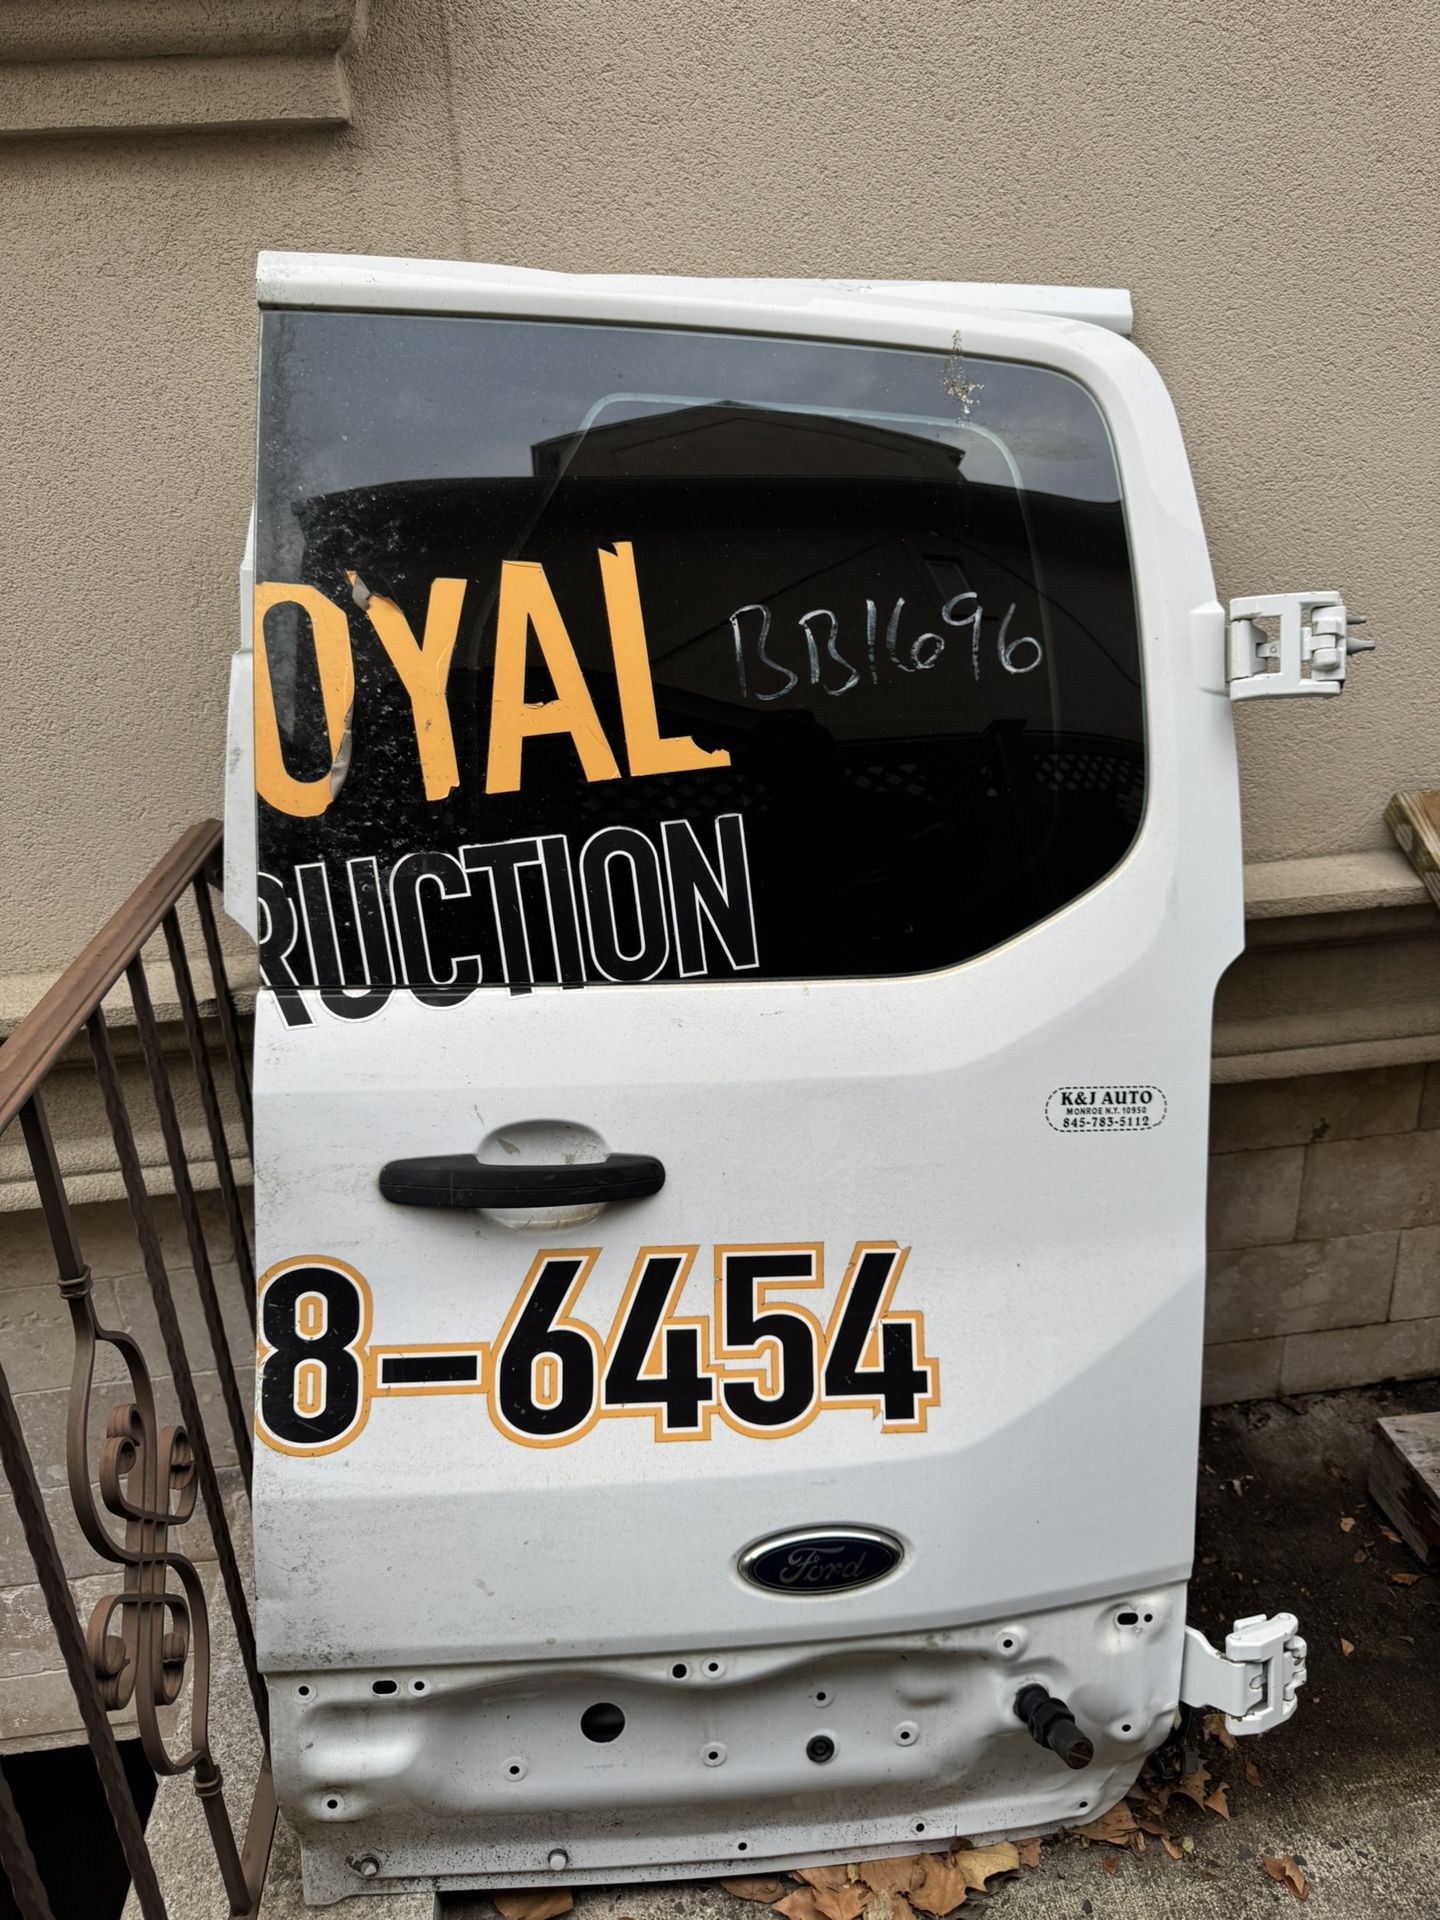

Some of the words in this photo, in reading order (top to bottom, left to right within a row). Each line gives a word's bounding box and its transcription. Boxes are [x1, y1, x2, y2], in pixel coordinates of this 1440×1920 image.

[729, 592, 1042, 700] BB1696
[255, 541, 731, 817] OYAL
[1060, 1091, 1096, 1106] K&J
[1101, 1090, 1153, 1105] AUTO
[1066, 1107, 1103, 1115] MONROE
[1105, 1107, 1120, 1115] N.Y.
[1122, 1106, 1147, 1114] 10950
[1063, 1116, 1149, 1128] 845-783-5112
[256, 1241, 940, 1457] 8-6454
[779, 1546, 868, 1584] Ford
